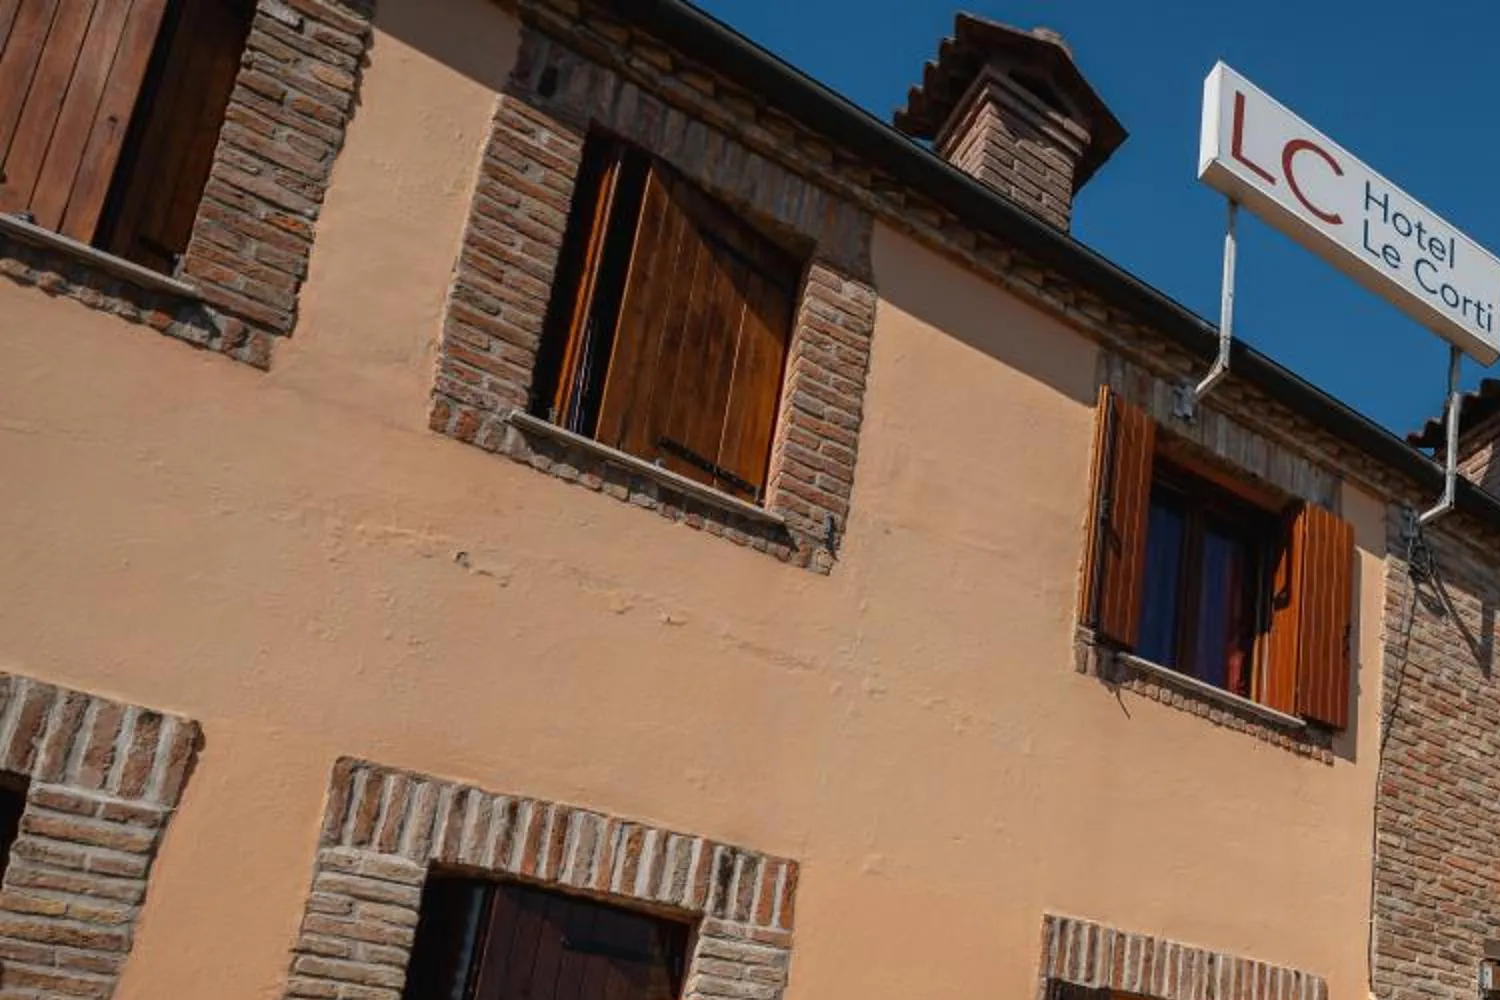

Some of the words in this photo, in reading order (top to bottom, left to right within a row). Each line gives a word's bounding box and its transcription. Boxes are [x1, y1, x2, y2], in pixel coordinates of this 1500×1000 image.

[1232, 91, 1344, 224] LC
[1363, 219, 1400, 269] Le
[1414, 258, 1493, 333] Corti
[1364, 180, 1455, 269] Hotel
